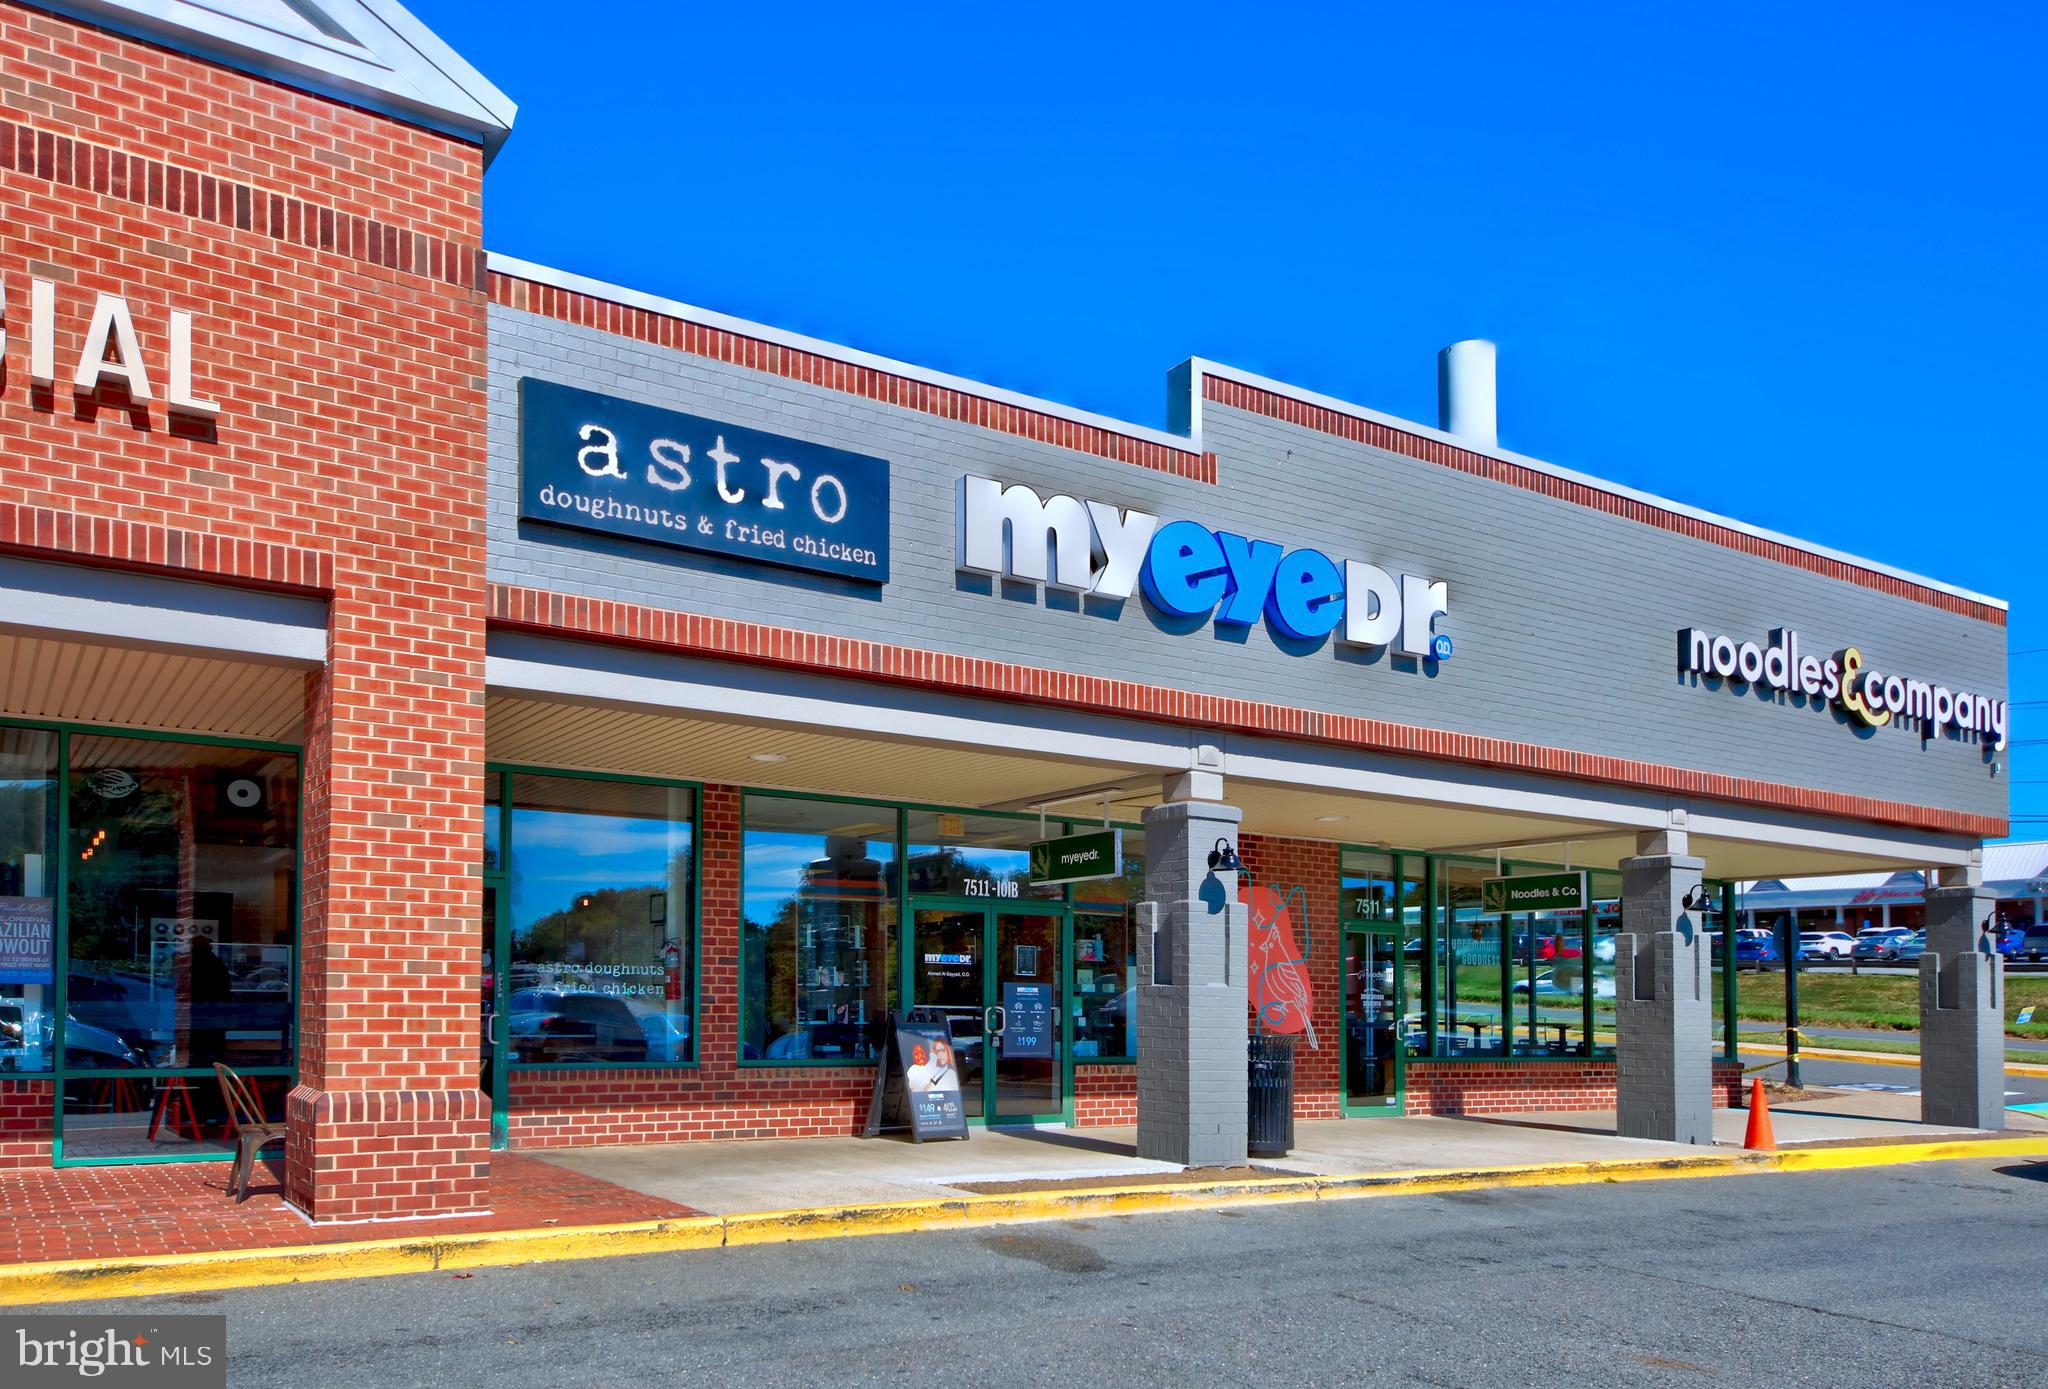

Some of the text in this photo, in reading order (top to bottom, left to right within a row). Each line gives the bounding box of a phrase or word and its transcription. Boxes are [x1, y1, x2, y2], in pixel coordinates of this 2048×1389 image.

[0, 276, 220, 415] IAL
[576, 423, 848, 524] astro
[540, 484, 878, 566] doughnuts & fried chicken
[1061, 849, 1100, 864] myeyedr.
[1511, 886, 1580, 899] Noodles & Co.
[1355, 898, 1380, 915] 7511
[537, 961, 665, 977] astro doughnuts
[555, 981, 596, 994] fried
[603, 982, 665, 995] chicken
